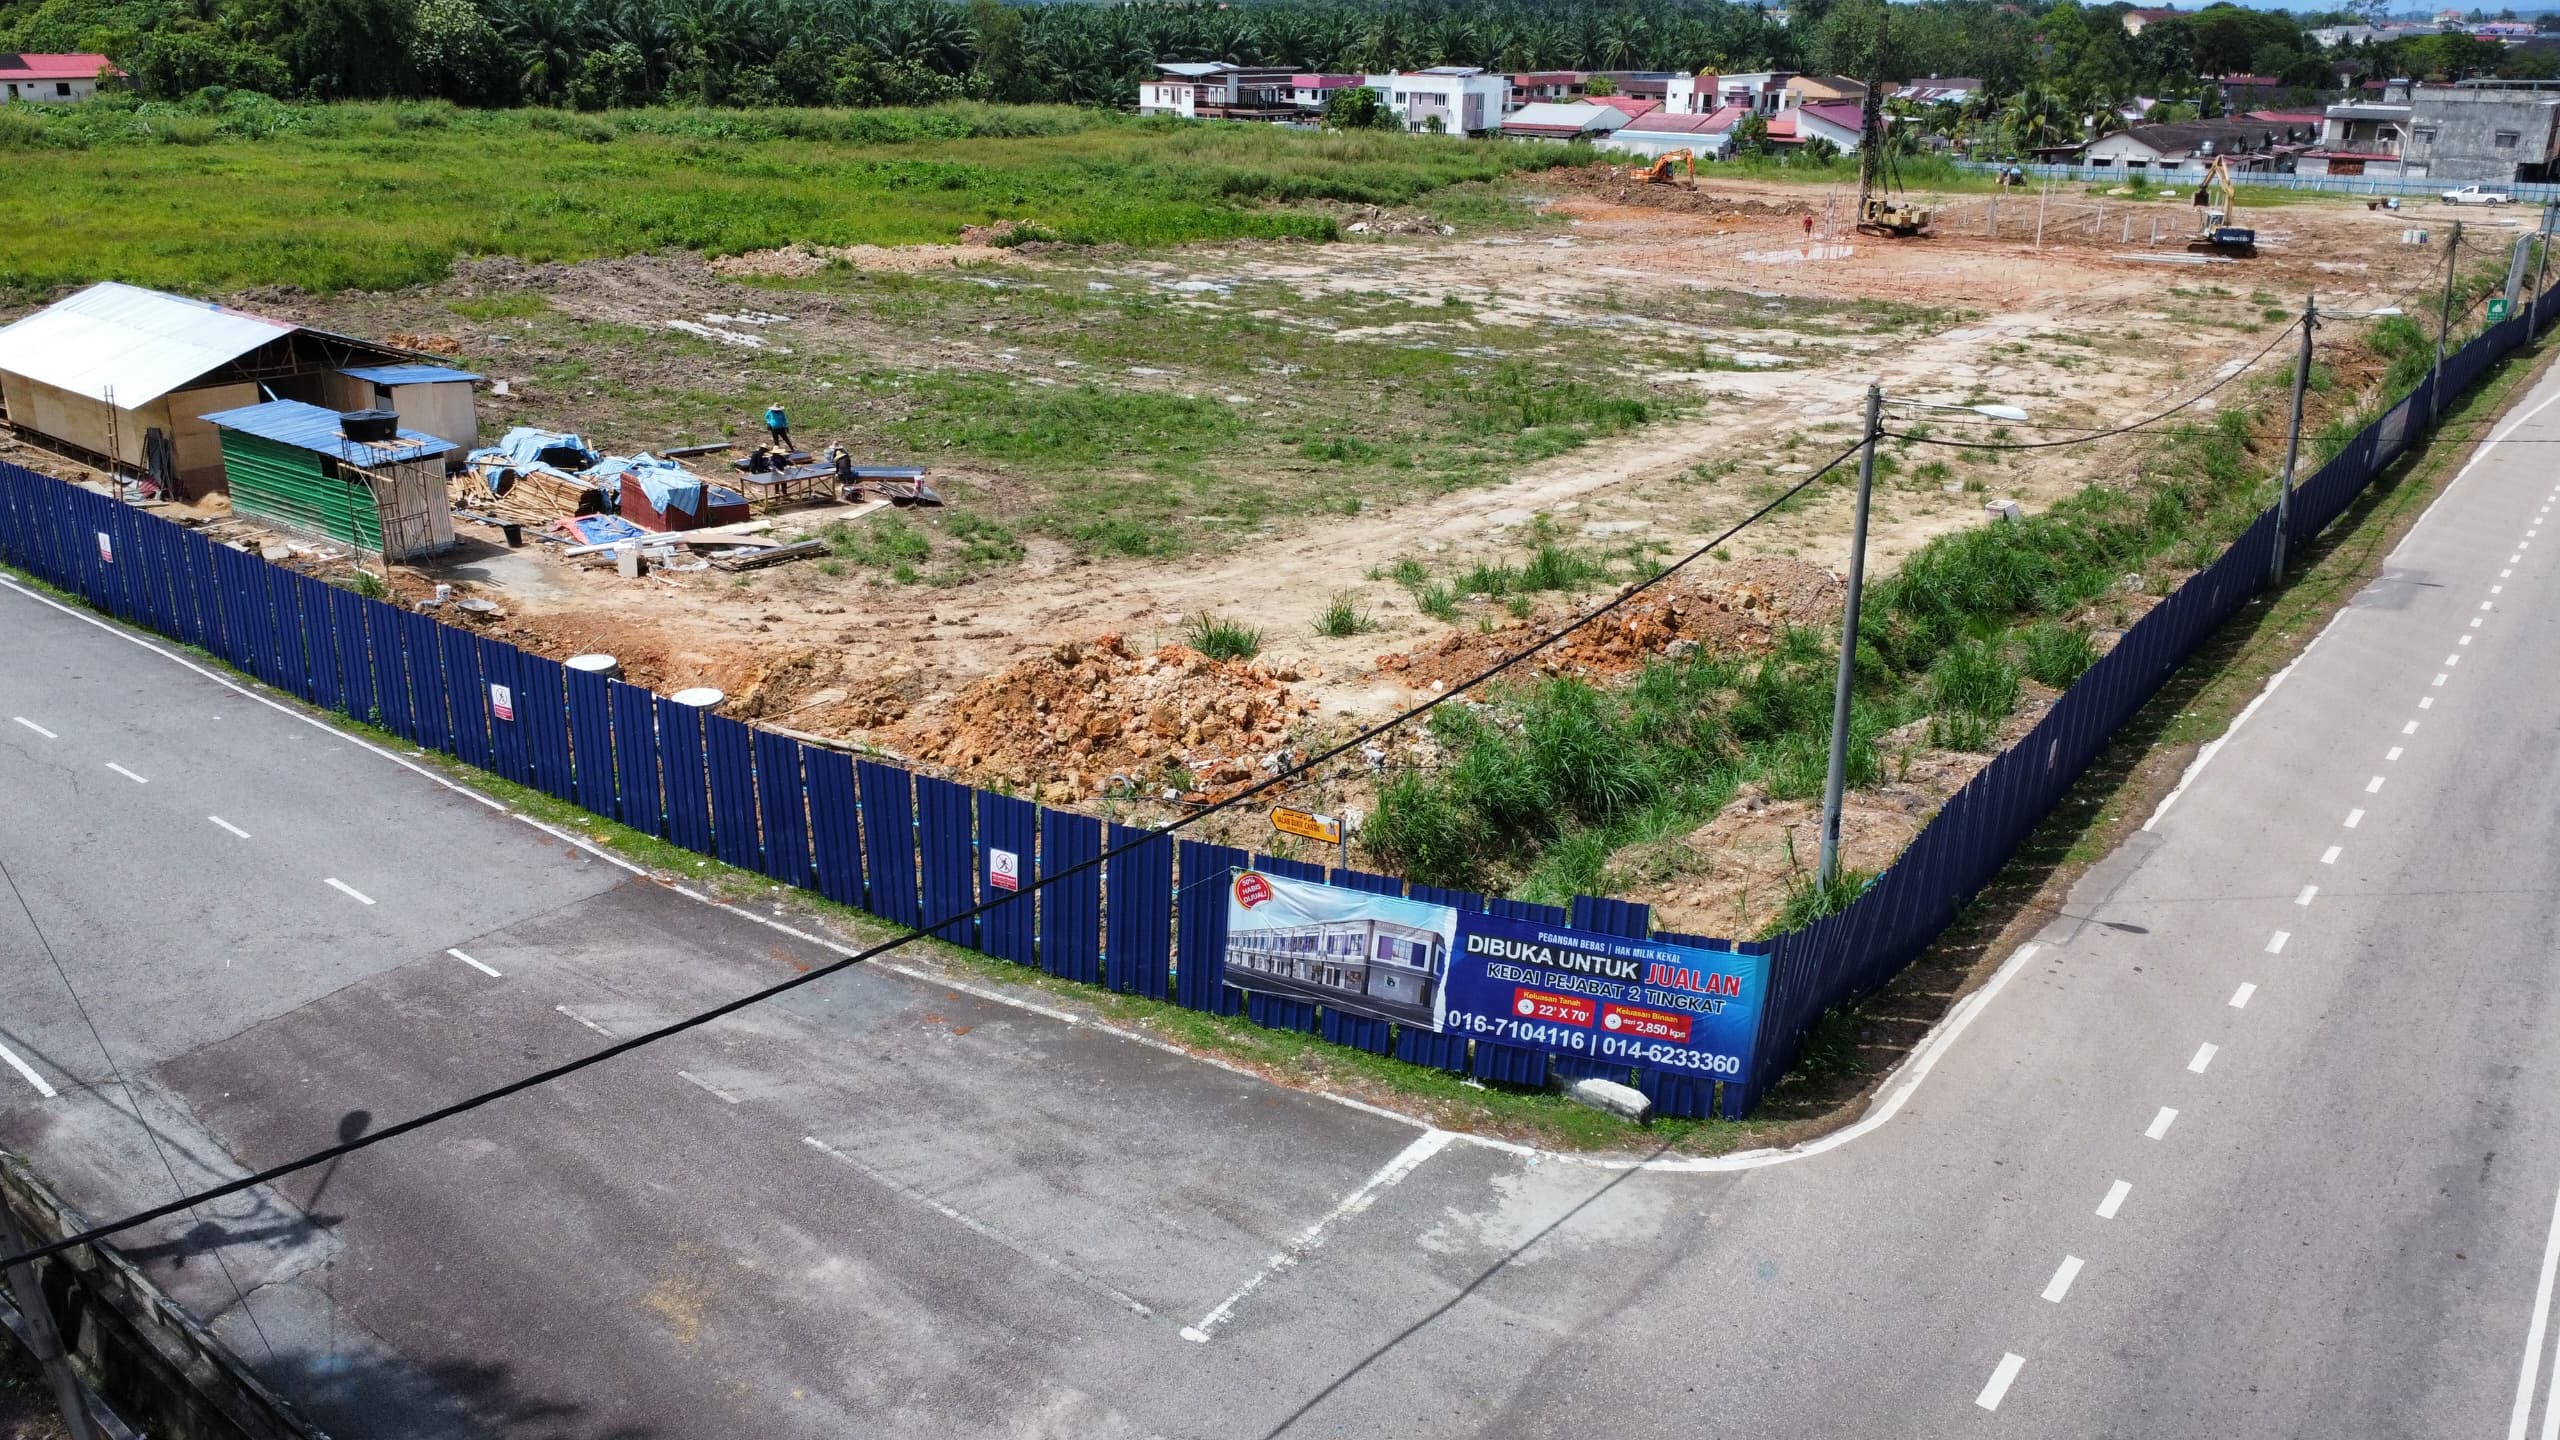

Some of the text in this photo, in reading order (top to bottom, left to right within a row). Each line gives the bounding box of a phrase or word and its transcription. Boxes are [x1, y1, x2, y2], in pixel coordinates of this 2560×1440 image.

[1538, 931, 1579, 947] PEGANGAN
[1580, 939, 1606, 952] BEBAS
[1615, 945, 1631, 956] HAK
[1632, 948, 1655, 959] MILIK
[1656, 951, 1681, 964] KEKAL
[1467, 934, 1742, 997] DIBUKA UNTUK JUALAN
[1487, 962, 1726, 1015] KEDAI PEJABAT 2 TINGKAT
[1523, 991, 1581, 1007] Keluasan Tanah
[1538, 1004, 1589, 1022] 22' X 70'
[1652, 1012, 1679, 1024] Binaan
[1635, 1021, 1668, 1035] 2,850
[1448, 1010, 1585, 1049] 016-7104116
[1602, 1037, 1740, 1074] 014-6233360
